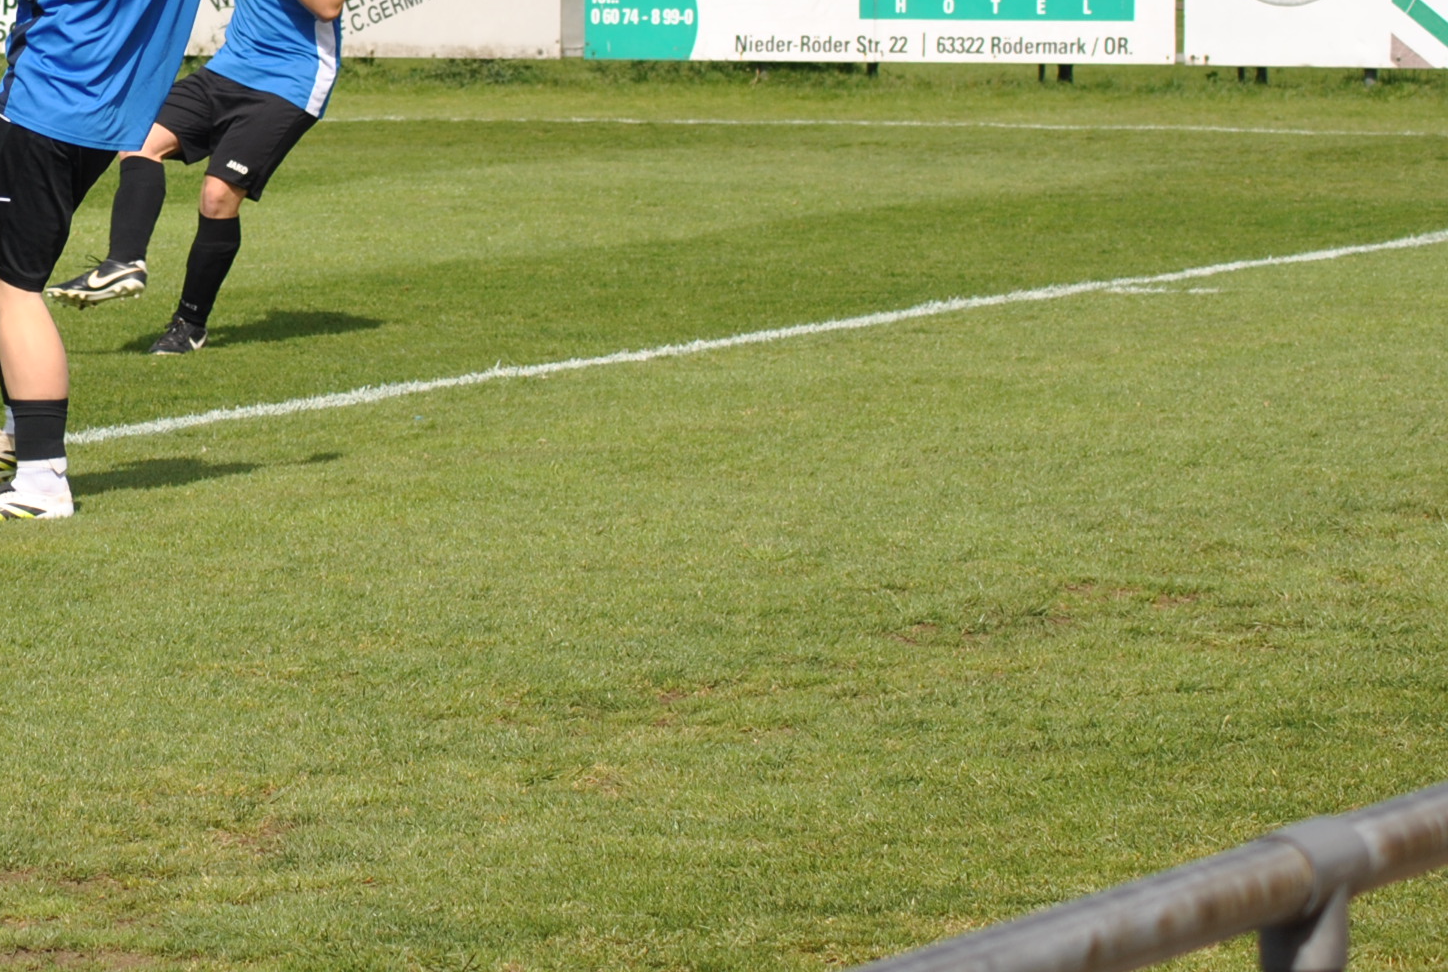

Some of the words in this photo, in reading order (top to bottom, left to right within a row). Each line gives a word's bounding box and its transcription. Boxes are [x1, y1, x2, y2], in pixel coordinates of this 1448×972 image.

[735, 34, 851, 54] Nieder-Röder
[889, 35, 908, 54] 22
[936, 36, 985, 54] 63322
[991, 36, 1086, 55] Rödermark
